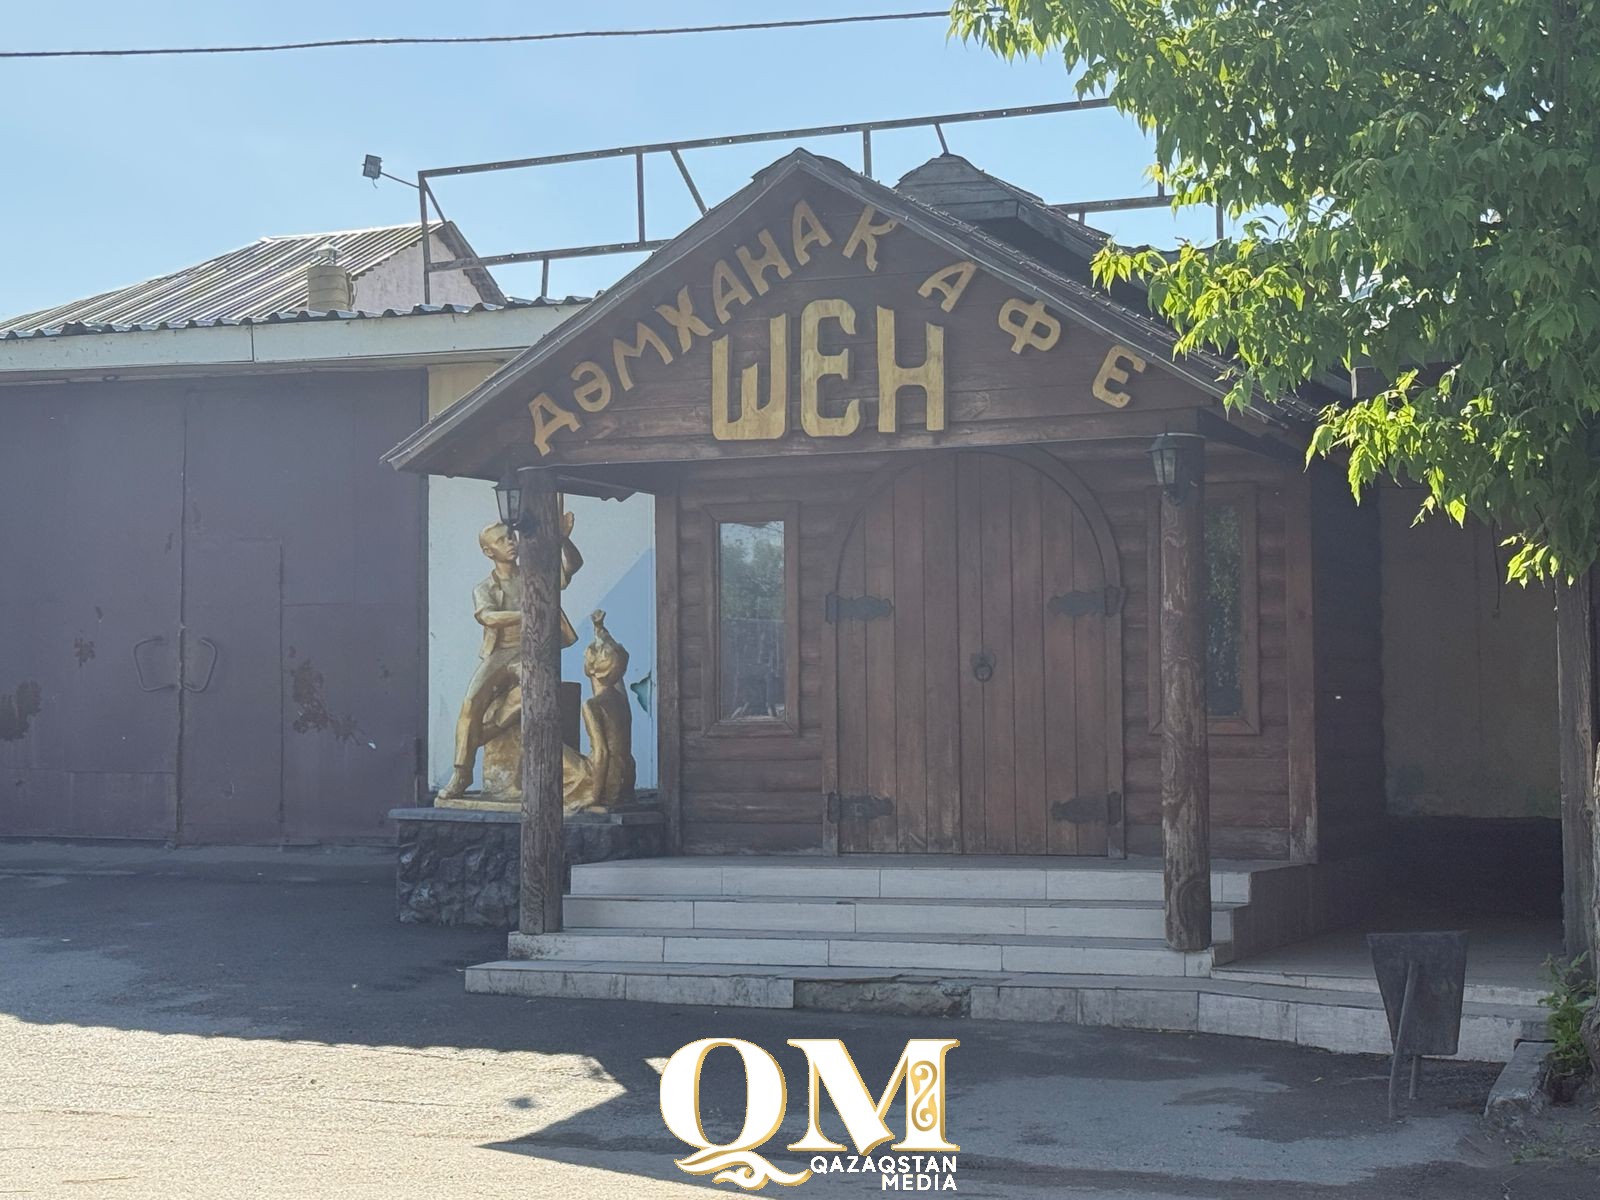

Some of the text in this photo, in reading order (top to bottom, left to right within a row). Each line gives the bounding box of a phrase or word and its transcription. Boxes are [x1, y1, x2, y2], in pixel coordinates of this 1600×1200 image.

[527, 200, 1147, 456] ДӘМХАНА КАФЕ
[712, 299, 944, 441] ШЕН
